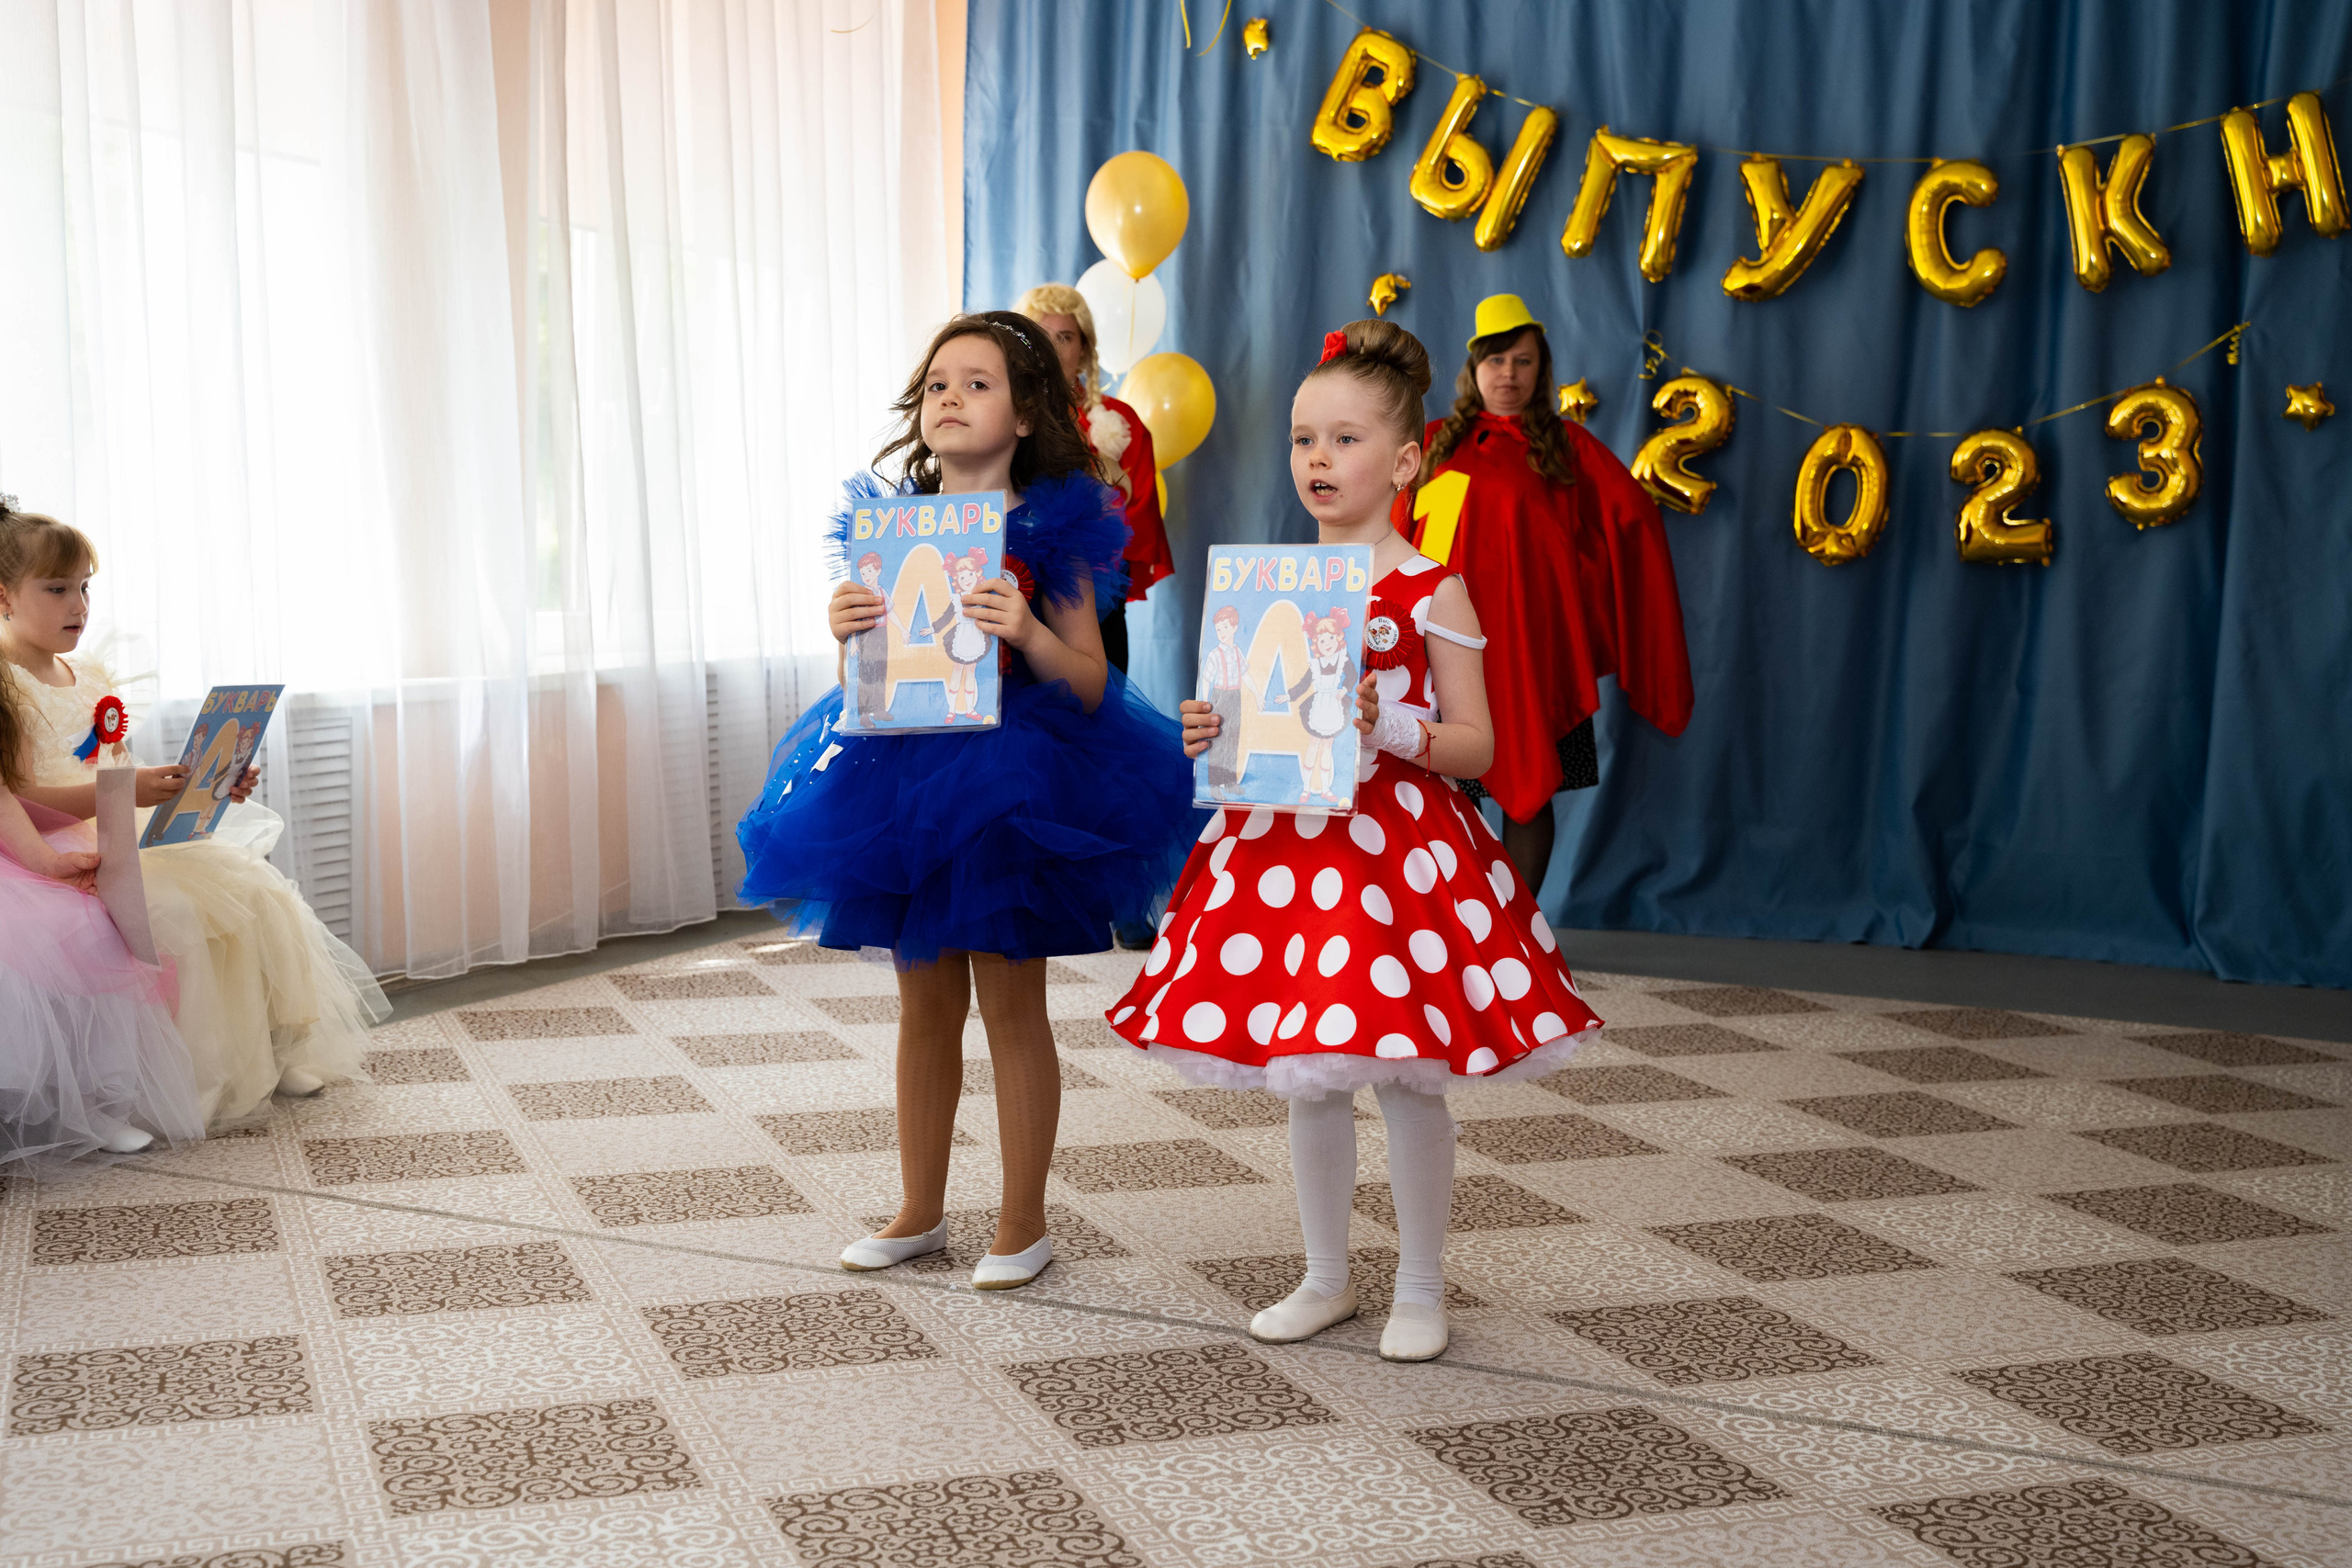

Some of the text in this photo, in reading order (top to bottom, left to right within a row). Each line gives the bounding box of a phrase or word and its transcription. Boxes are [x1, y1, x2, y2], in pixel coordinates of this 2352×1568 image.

[1413, 469, 1470, 567] 1
[1630, 372, 2204, 566] 2023
[854, 502, 1001, 540] БУКВАРЬ
[1212, 557, 1367, 592] БУКВАРЬ
[884, 543, 979, 715] А
[200, 690, 277, 715] БУКВАРЬ
[1237, 599, 1336, 795] А
